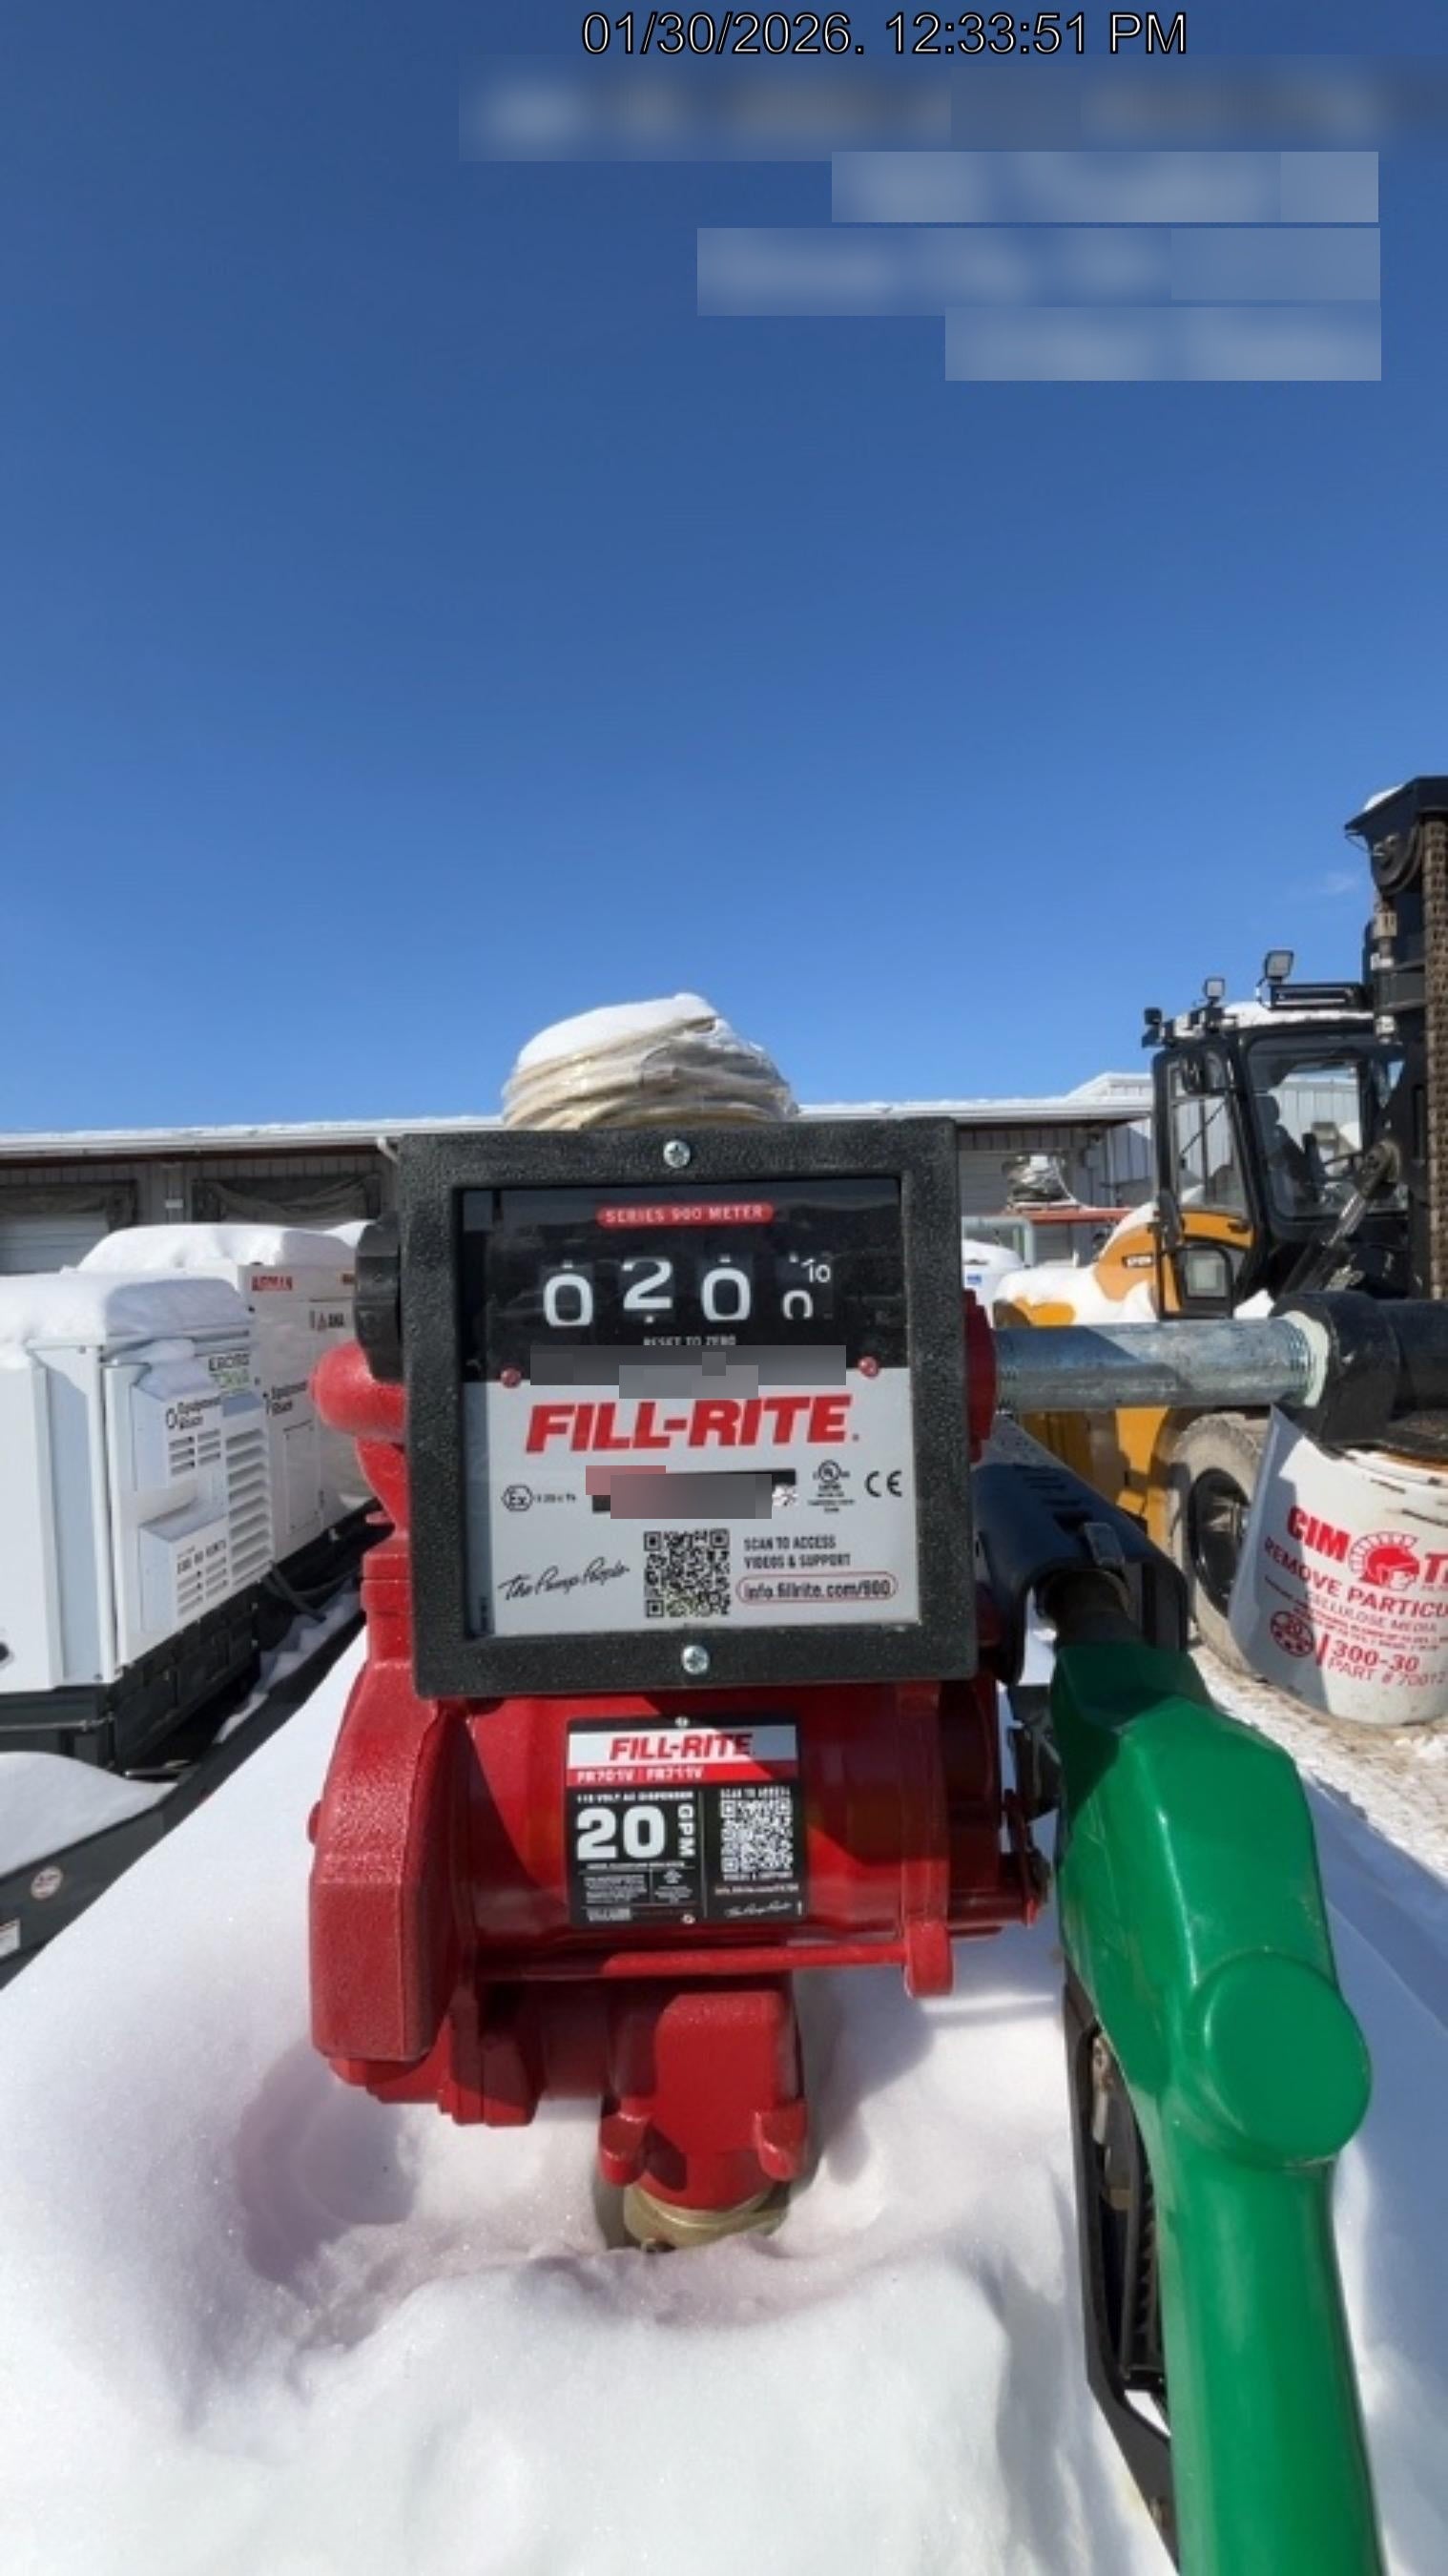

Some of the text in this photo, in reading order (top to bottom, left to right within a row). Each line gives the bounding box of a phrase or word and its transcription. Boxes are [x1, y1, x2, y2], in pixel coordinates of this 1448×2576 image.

[605, 1204, 764, 1224] SERIES 900 METER
[744, 1534, 837, 1551] SCAN TO ACCESS
[1288, 1505, 1448, 1585] CIM T
[744, 1555, 785, 1569] VIDEOS
[798, 1553, 851, 1567] SUPPORT
[1264, 1536, 1343, 1598] REMOVE
[1327, 1657, 1376, 1681] PART
[1334, 1639, 1420, 1672] 300-30
[576, 1805, 666, 1861] 20
[677, 1802, 696, 1859] GPM
